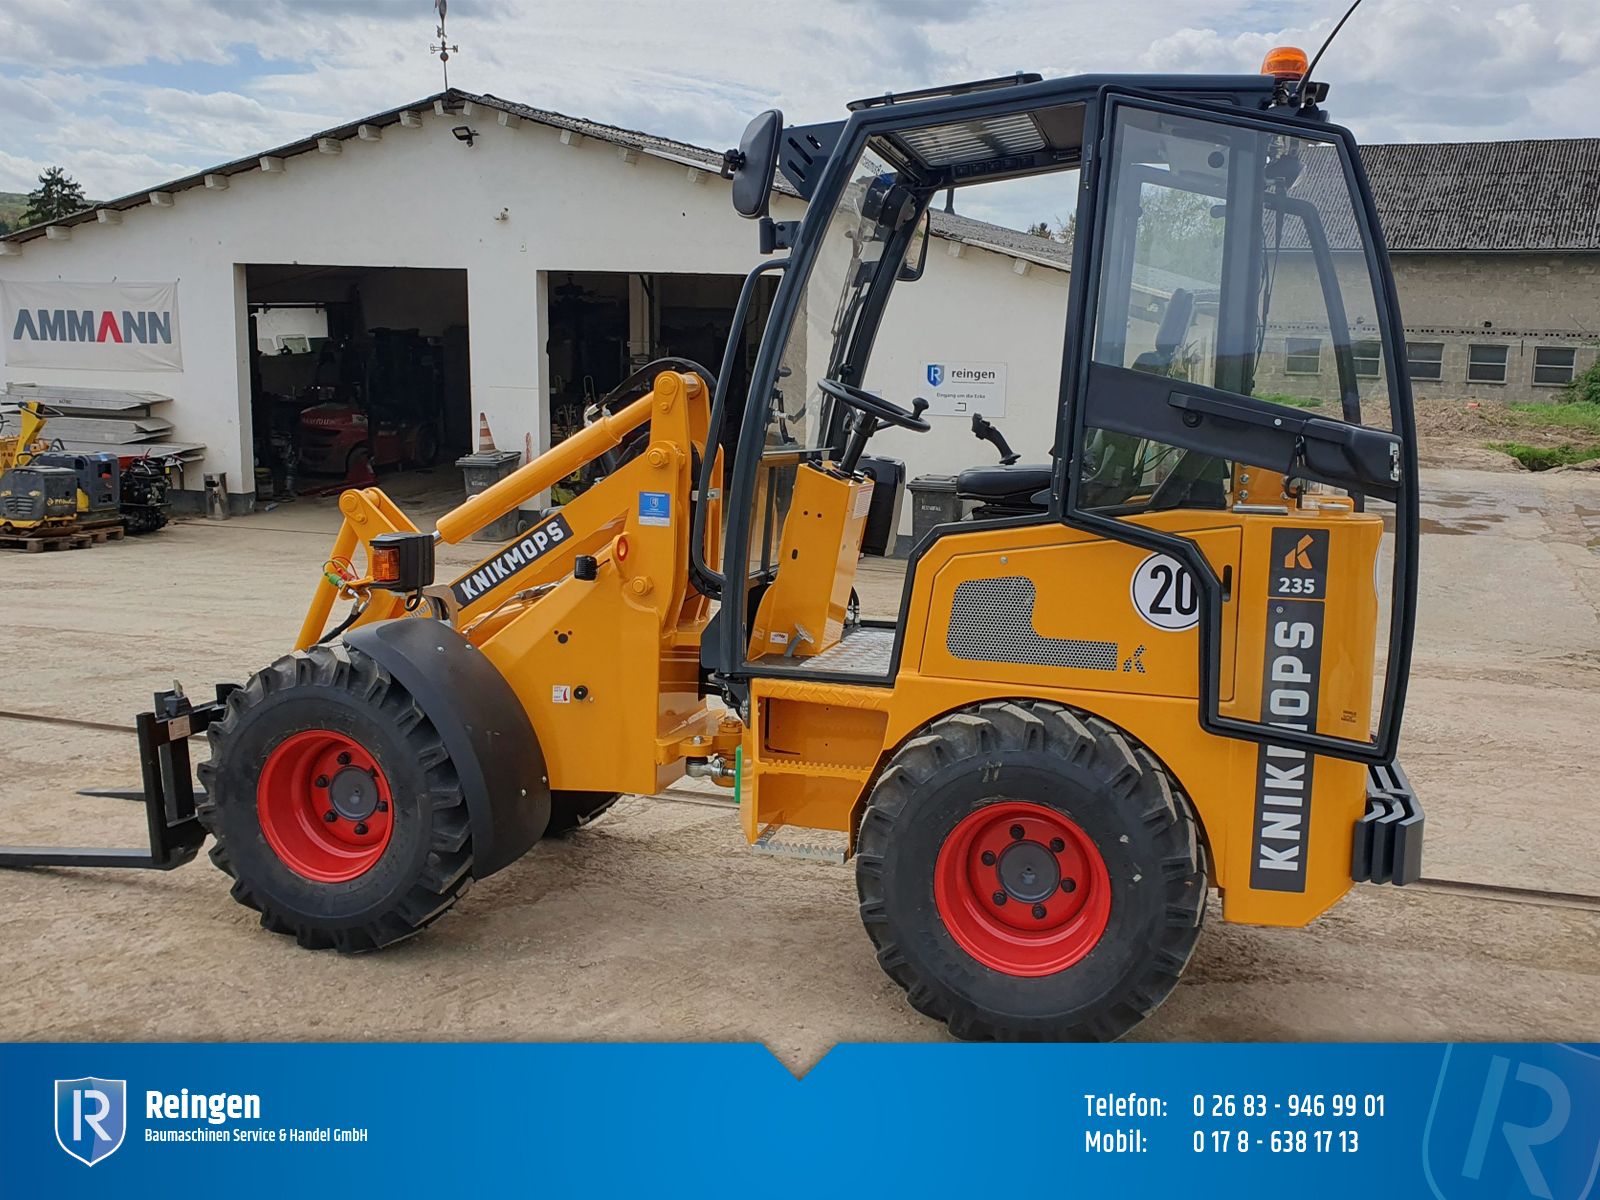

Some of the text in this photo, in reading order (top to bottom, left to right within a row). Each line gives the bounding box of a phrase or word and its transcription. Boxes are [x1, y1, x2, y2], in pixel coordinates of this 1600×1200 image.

[13, 308, 172, 344] AMMANN
[951, 368, 996, 381] reingen
[460, 521, 565, 600] KNIKMOPS
[1149, 564, 1198, 615] 20
[1278, 577, 1315, 594] 235
